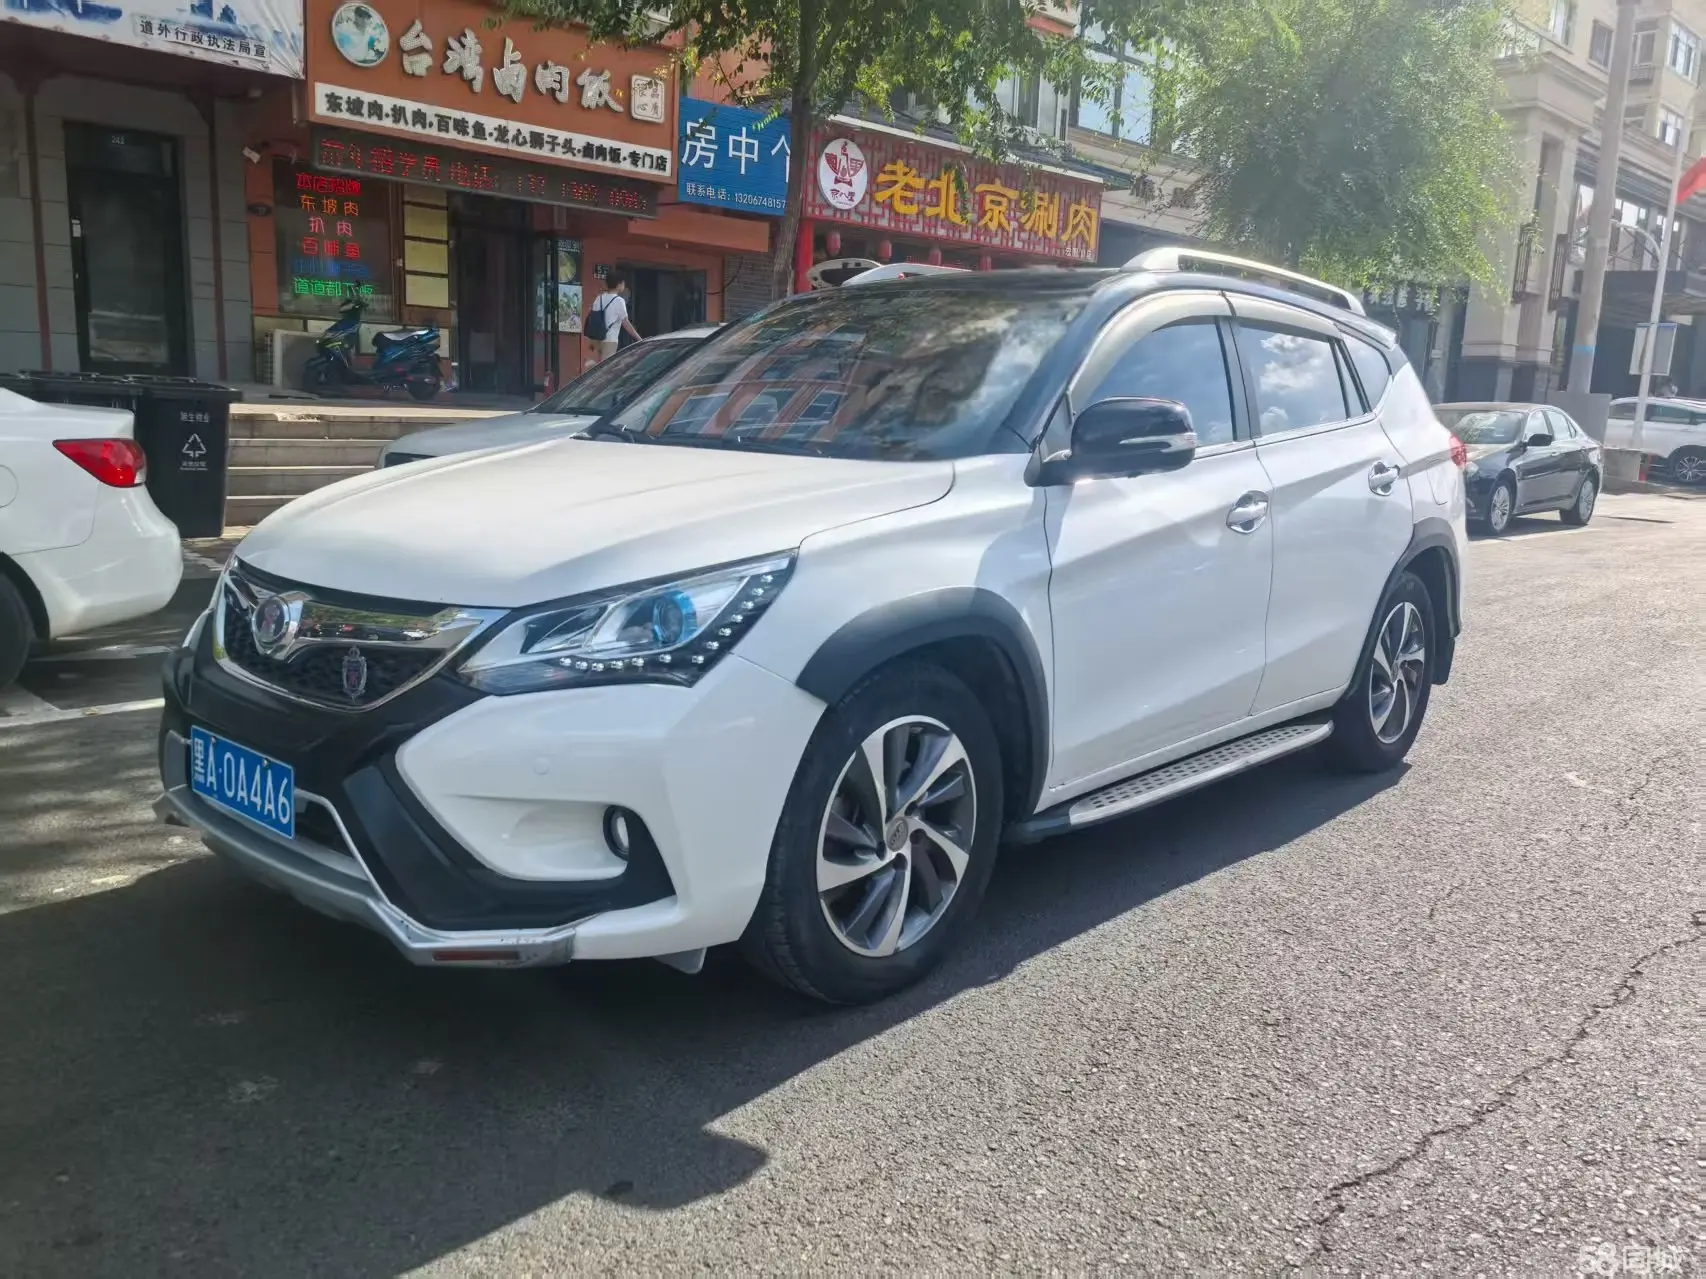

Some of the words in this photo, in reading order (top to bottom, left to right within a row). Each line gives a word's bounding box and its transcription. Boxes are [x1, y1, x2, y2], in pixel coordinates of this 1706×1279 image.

[140, 20, 266, 58] 道外行政执法局宣
[400, 18, 624, 113] 台湾卤肉饭
[301, 194, 359, 216] 东坡肉
[874, 159, 1097, 250] 老北京涮肉
[309, 217, 353, 236] 扒肉
